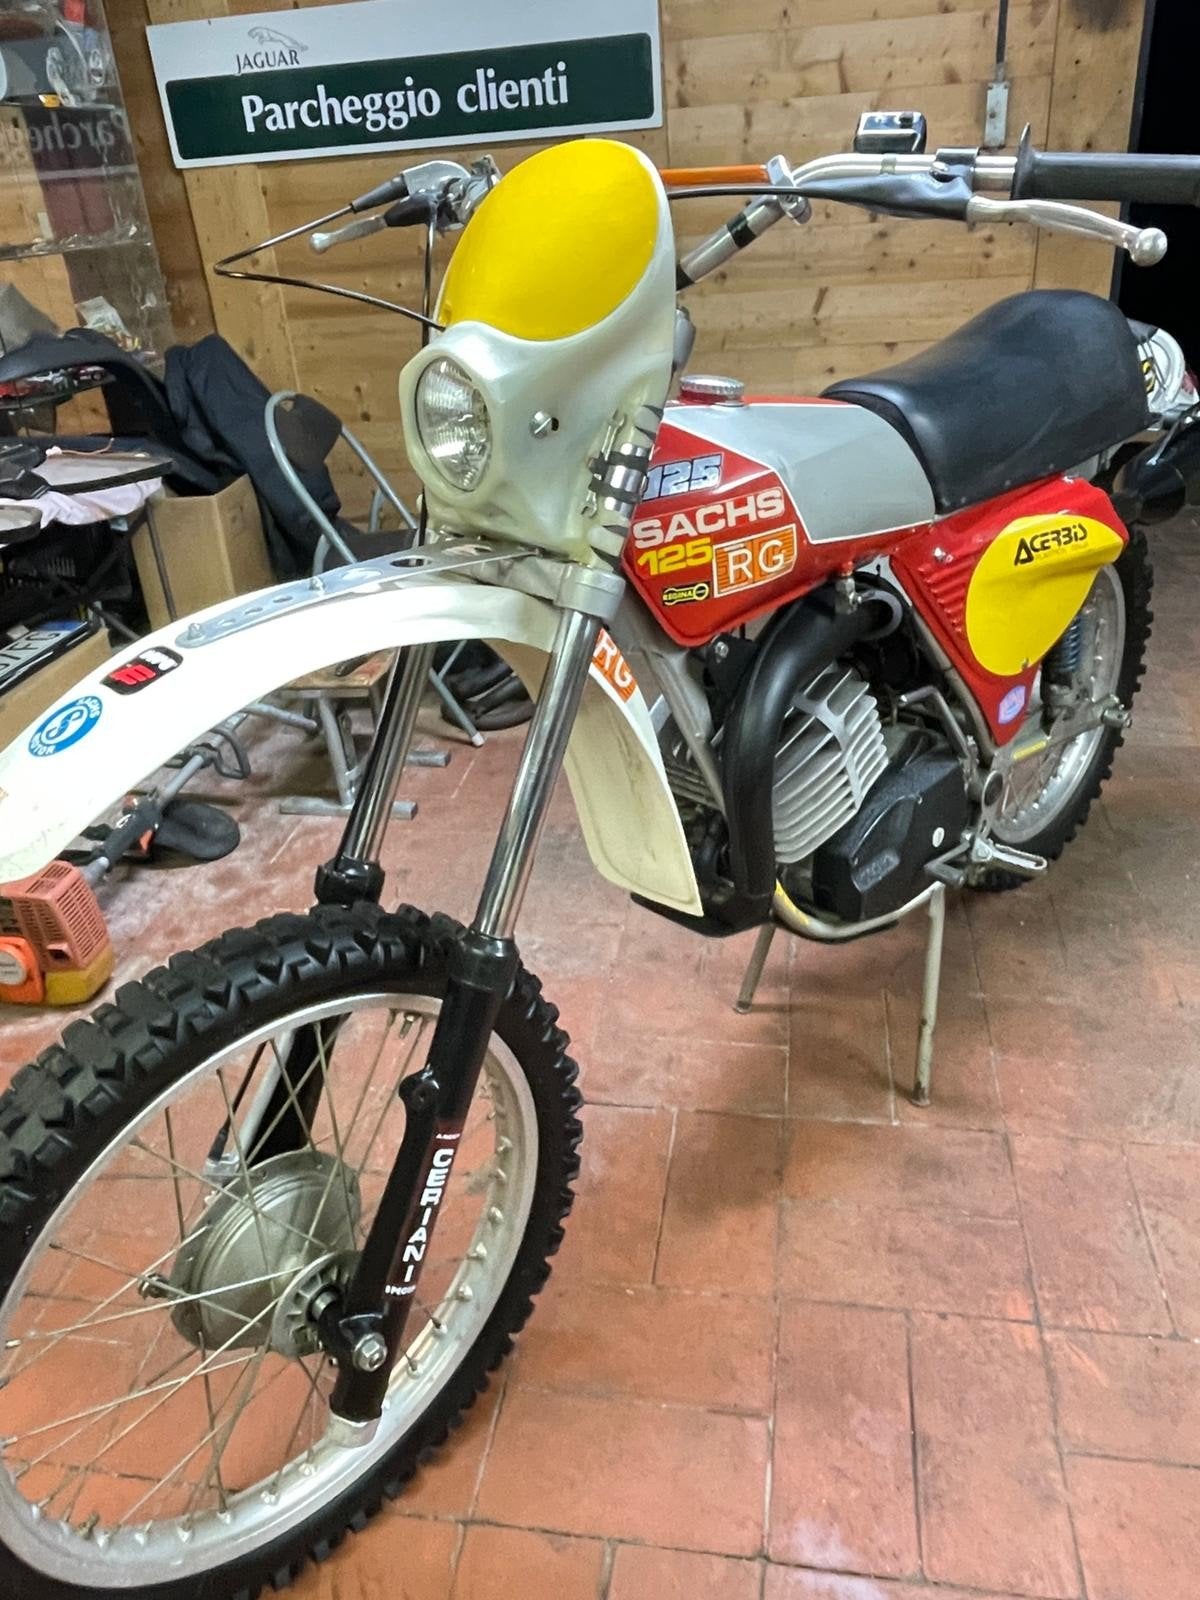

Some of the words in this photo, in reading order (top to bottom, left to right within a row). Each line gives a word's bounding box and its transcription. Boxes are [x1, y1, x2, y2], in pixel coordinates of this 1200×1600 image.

[236, 49, 300, 74] JAGUAR
[241, 76, 441, 133] Parcheggio
[457, 61, 569, 113] clienti
[642, 453, 722, 501] 125
[632, 487, 786, 550] SACHS
[637, 537, 714, 576] 125
[727, 539, 786, 584] RG
[402, 1148, 455, 1283] CERIANI
